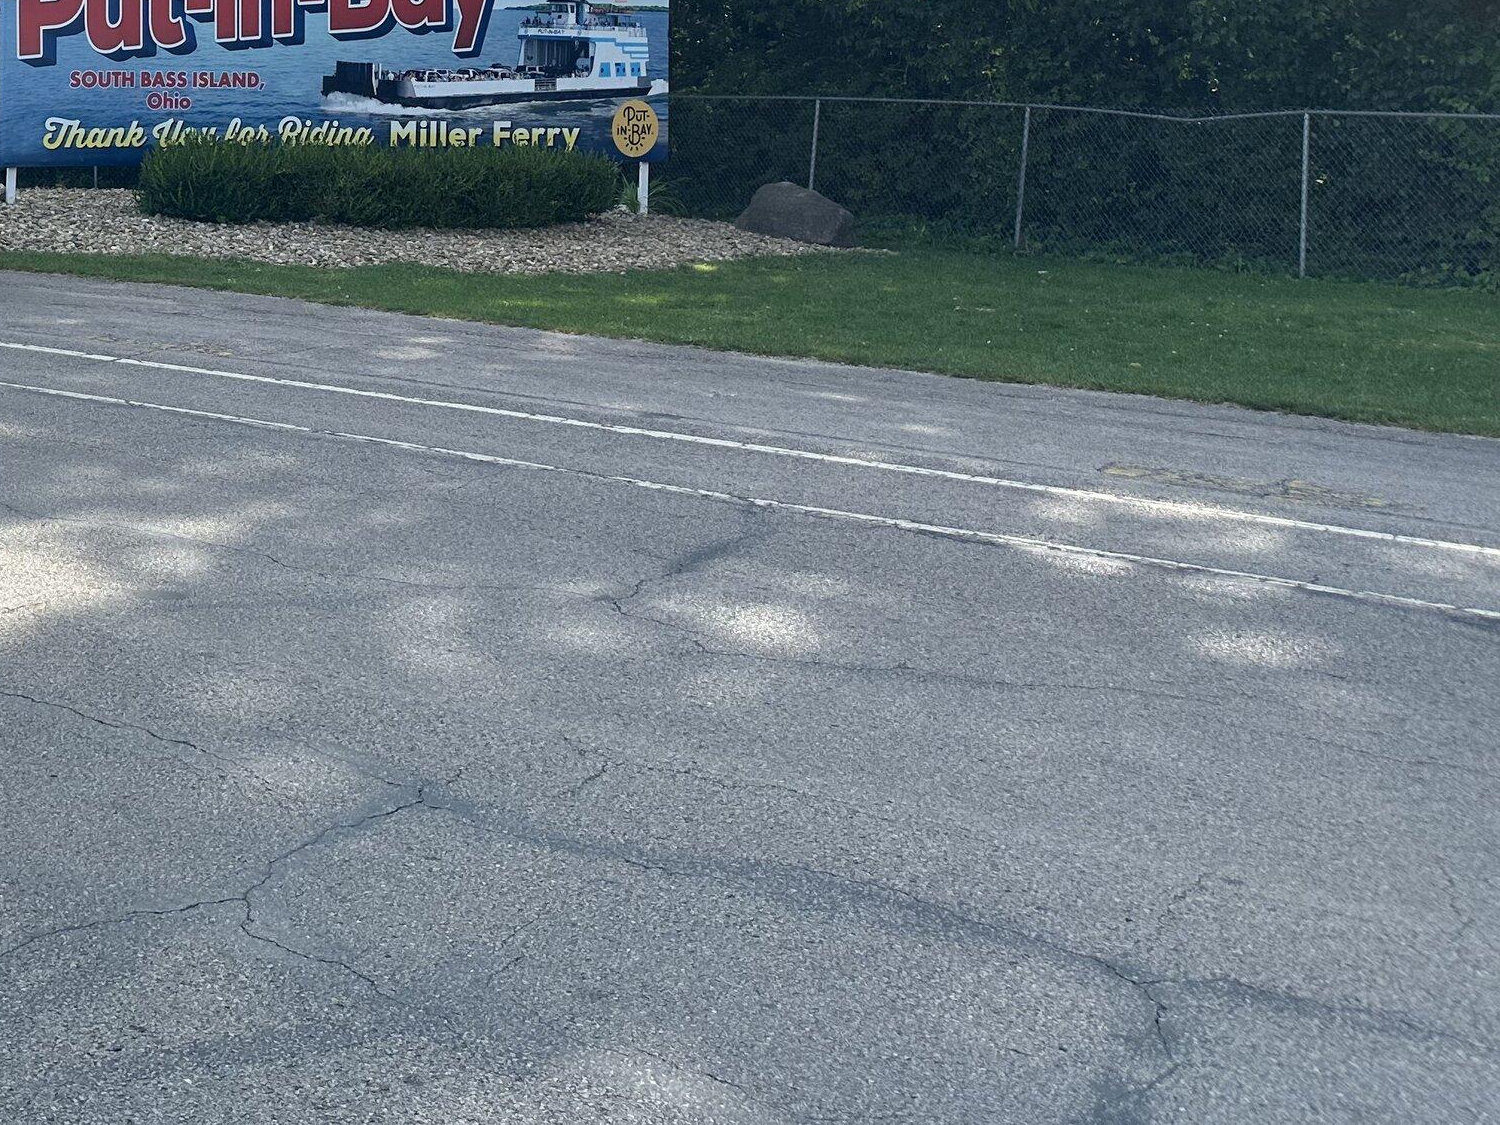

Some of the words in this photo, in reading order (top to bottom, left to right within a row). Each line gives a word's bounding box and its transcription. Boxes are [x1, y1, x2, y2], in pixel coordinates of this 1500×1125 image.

[69, 70, 135, 88] SOUTH
[140, 71, 188, 88] BASS
[192, 71, 265, 91] ISLAND,
[146, 91, 192, 110] Ohio
[43, 116, 147, 150] Thank
[390, 120, 483, 147] Miller
[493, 120, 581, 152] Ferry
